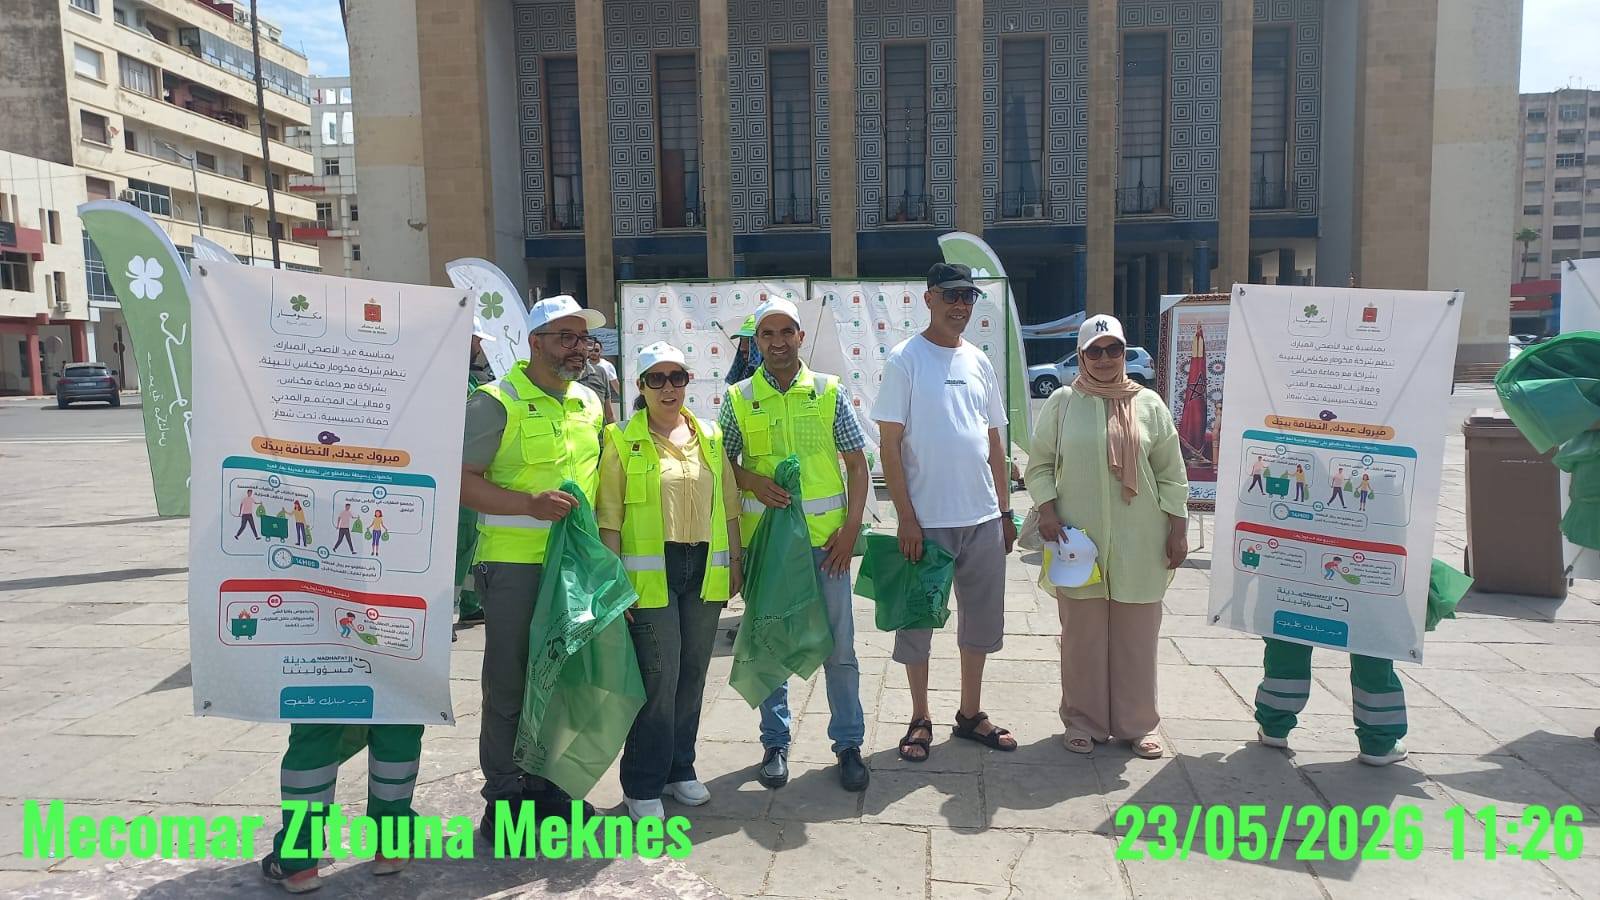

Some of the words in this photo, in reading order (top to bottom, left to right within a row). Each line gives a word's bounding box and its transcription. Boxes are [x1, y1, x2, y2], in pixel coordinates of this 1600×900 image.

[1095, 319, 1109, 332] NY
[307, 344, 340, 356] الأضحى
[342, 348, 356, 358] عيد
[358, 348, 394, 360] بمناسبة
[292, 358, 326, 370] مكناس
[328, 361, 356, 373] مكومار
[357, 364, 381, 376] شركة
[382, 367, 407, 378] تنظم
[314, 378, 341, 389] جماعة
[342, 382, 356, 391] مع
[357, 381, 387, 393] بشراكة
[303, 394, 345, 407] المجتمع
[346, 397, 384, 410] فعاليات
[385, 402, 391, 411] و
[296, 411, 317, 420] تحت
[366, 416, 389, 426] حملة
[1293, 419, 1328, 433] النظافة
[1357, 427, 1386, 439] مبروك
[285, 442, 329, 458] النظافة
[366, 450, 400, 464] مبروك
[282, 665, 354, 675] مسؤوليتنا
